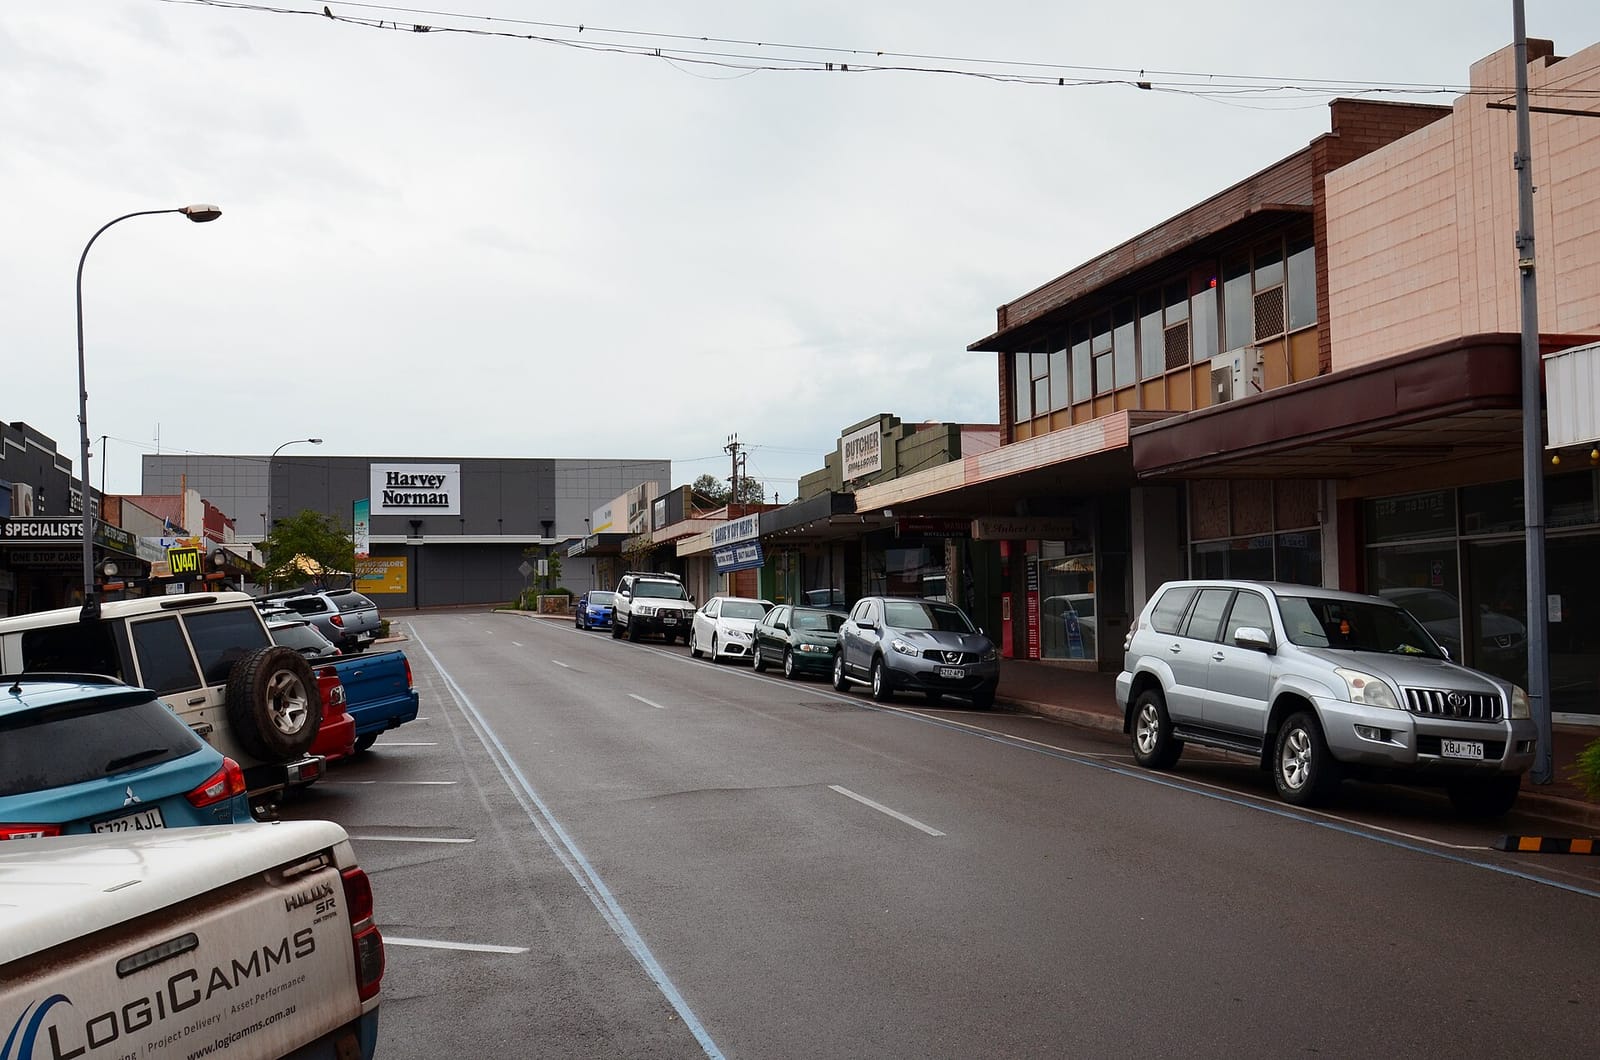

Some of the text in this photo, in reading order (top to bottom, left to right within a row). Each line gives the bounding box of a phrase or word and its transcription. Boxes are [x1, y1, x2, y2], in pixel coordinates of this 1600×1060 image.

[845, 431, 878, 458] BUTCHER
[386, 471, 446, 489] Harvey
[382, 490, 449, 505] Norman
[5, 523, 84, 537] SPECIALISTS
[13, 553, 30, 562] ONE
[34, 552, 56, 562] STOP
[172, 553, 197, 573] LV447
[284, 883, 334, 912] HILUX
[316, 898, 336, 915] SR
[148, 1030, 182, 1054] Project
[184, 1012, 221, 1034] Delivery
[231, 998, 253, 1014] Asset
[255, 974, 306, 1004] Performance
[187, 1004, 297, 1060] www.logicamms.com.au
